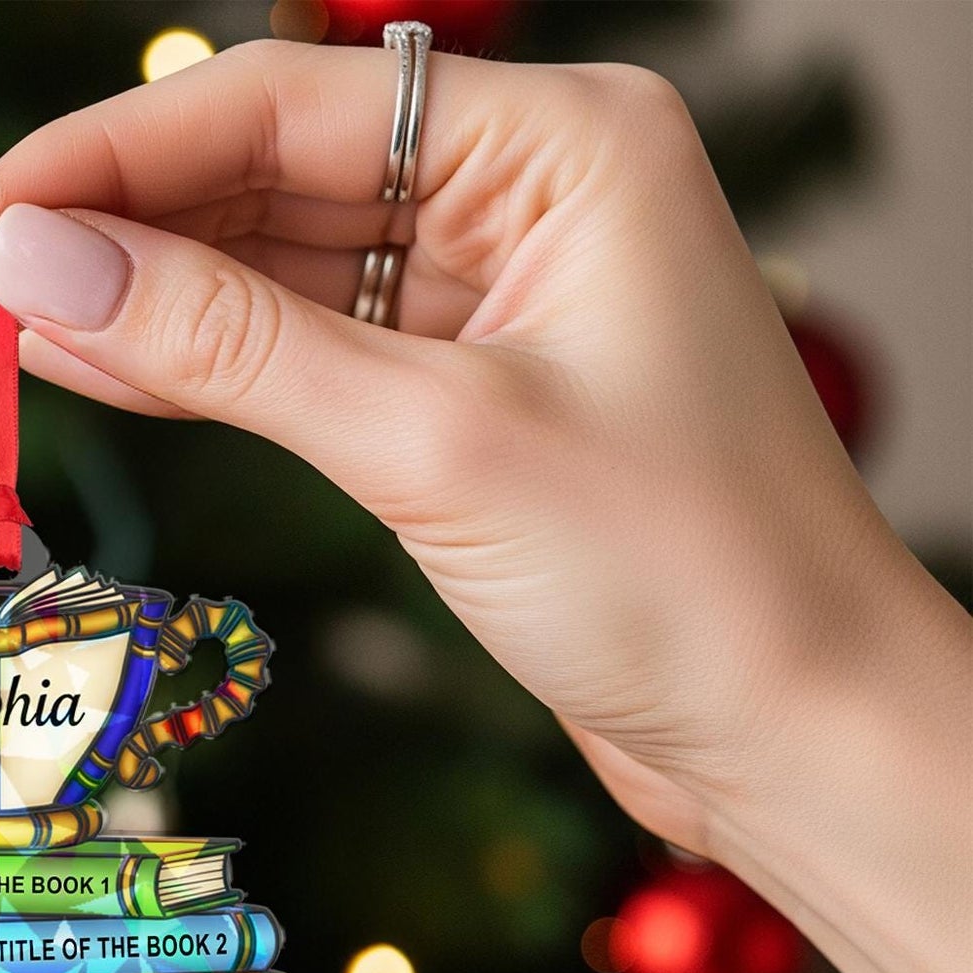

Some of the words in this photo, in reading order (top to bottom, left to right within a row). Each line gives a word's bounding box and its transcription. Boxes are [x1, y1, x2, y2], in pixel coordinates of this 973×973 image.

[31, 876, 94, 894] BOOK
[100, 877, 110, 895] 1
[62, 937, 91, 960] OF
[97, 936, 140, 959] THE
[147, 933, 211, 957] BOOK
[216, 933, 228, 955] 2
